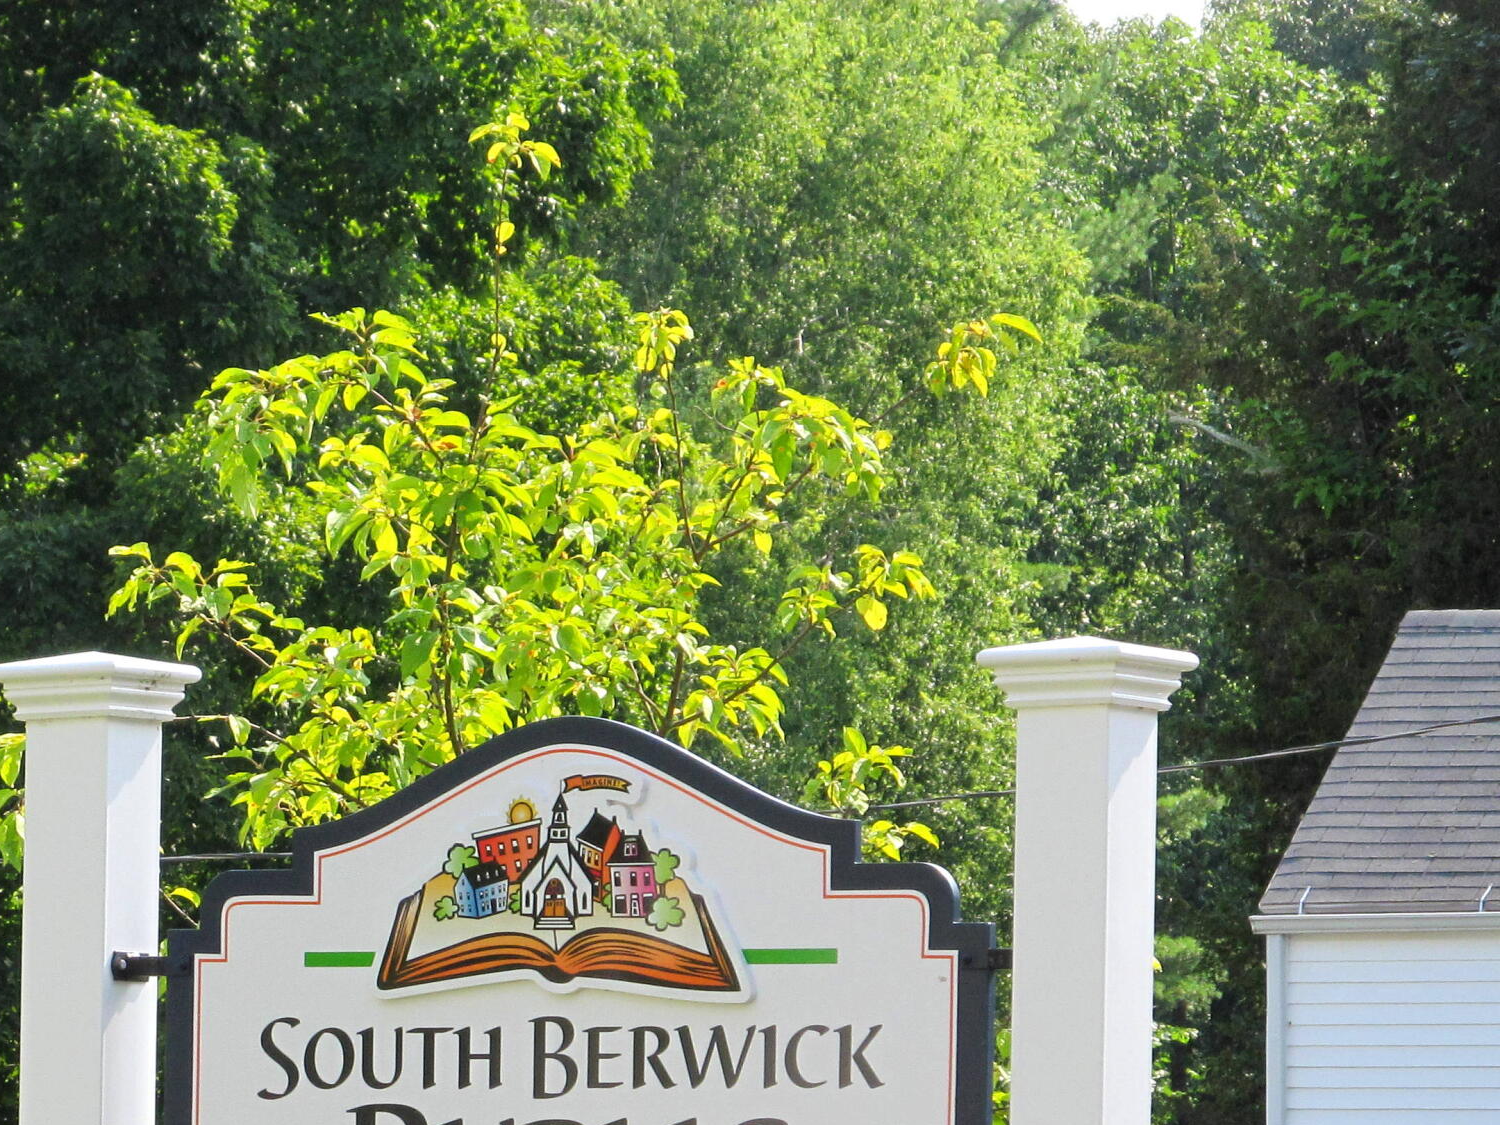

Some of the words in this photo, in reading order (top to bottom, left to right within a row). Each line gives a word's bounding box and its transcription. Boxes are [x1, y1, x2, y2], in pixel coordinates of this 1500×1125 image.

[581, 776, 621, 788] IMAGINE!
[257, 1016, 502, 1100] SOUTH
[528, 1015, 885, 1100] BERWICK
